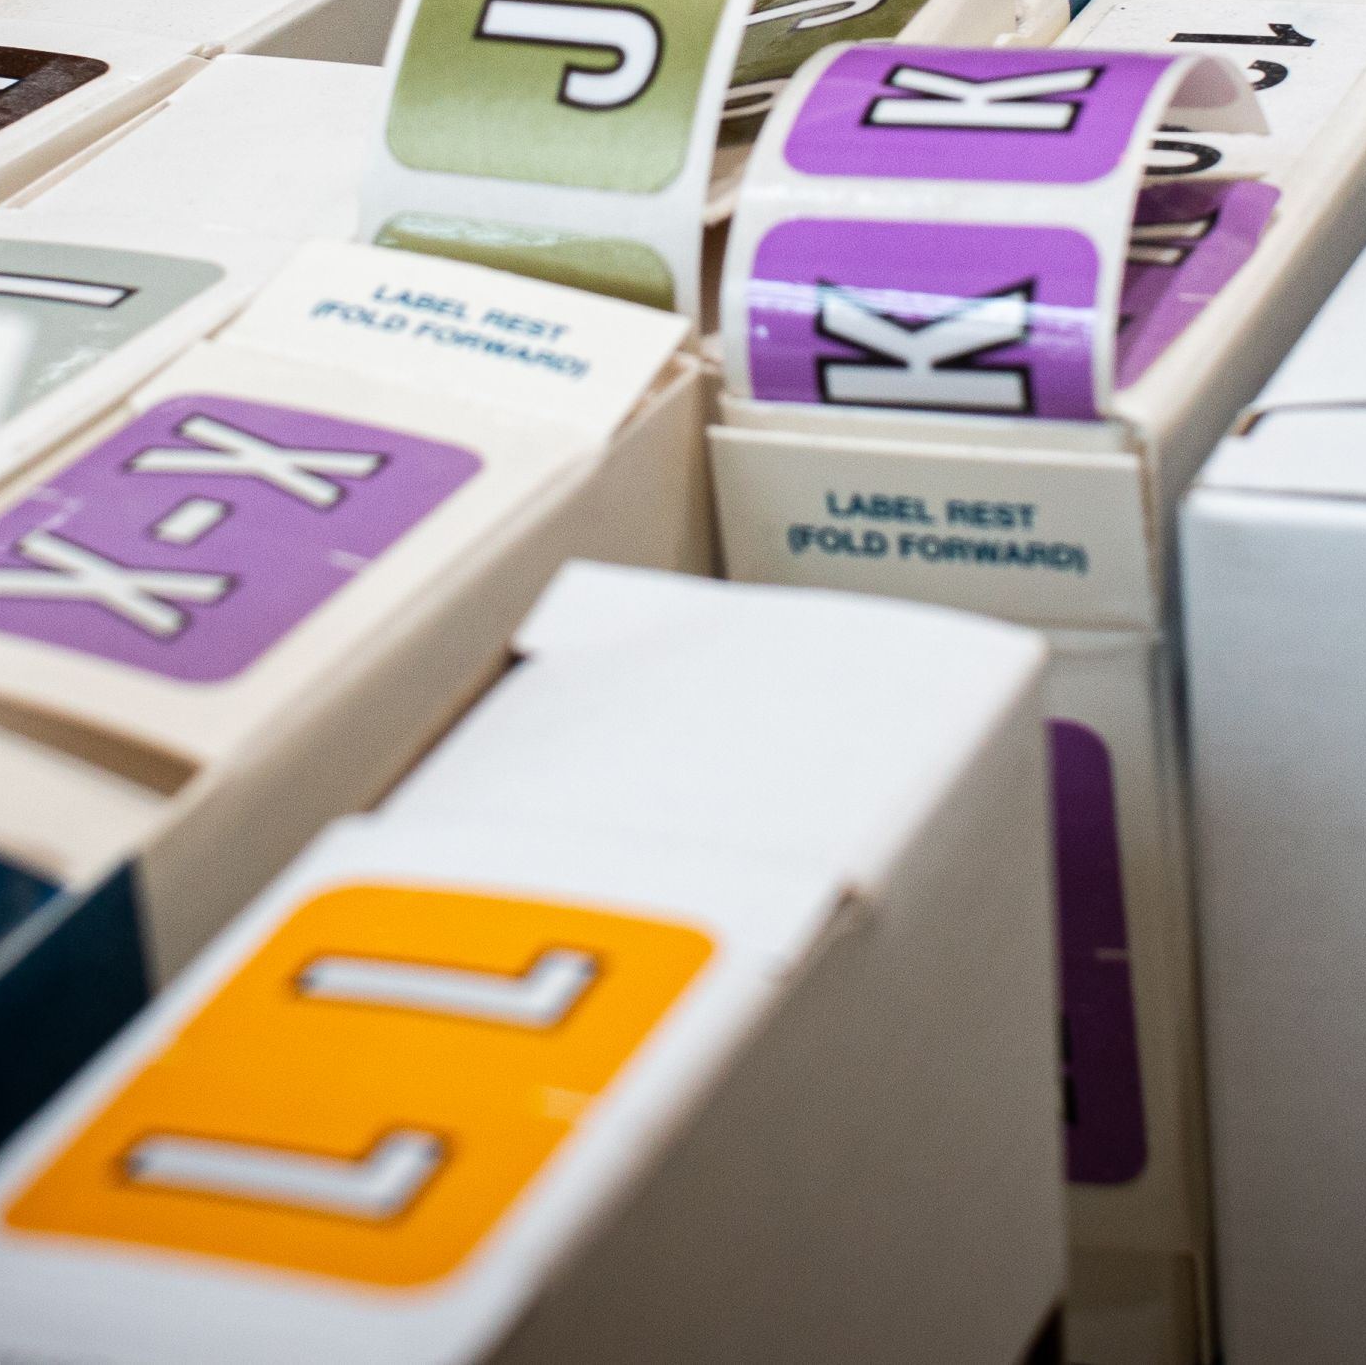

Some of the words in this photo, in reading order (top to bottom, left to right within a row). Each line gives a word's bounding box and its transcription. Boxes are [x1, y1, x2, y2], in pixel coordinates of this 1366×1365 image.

[861, 62, 1109, 134] K
[813, 277, 1037, 414] K
[115, 1125, 455, 1228] L
[290, 945, 608, 1031] L
